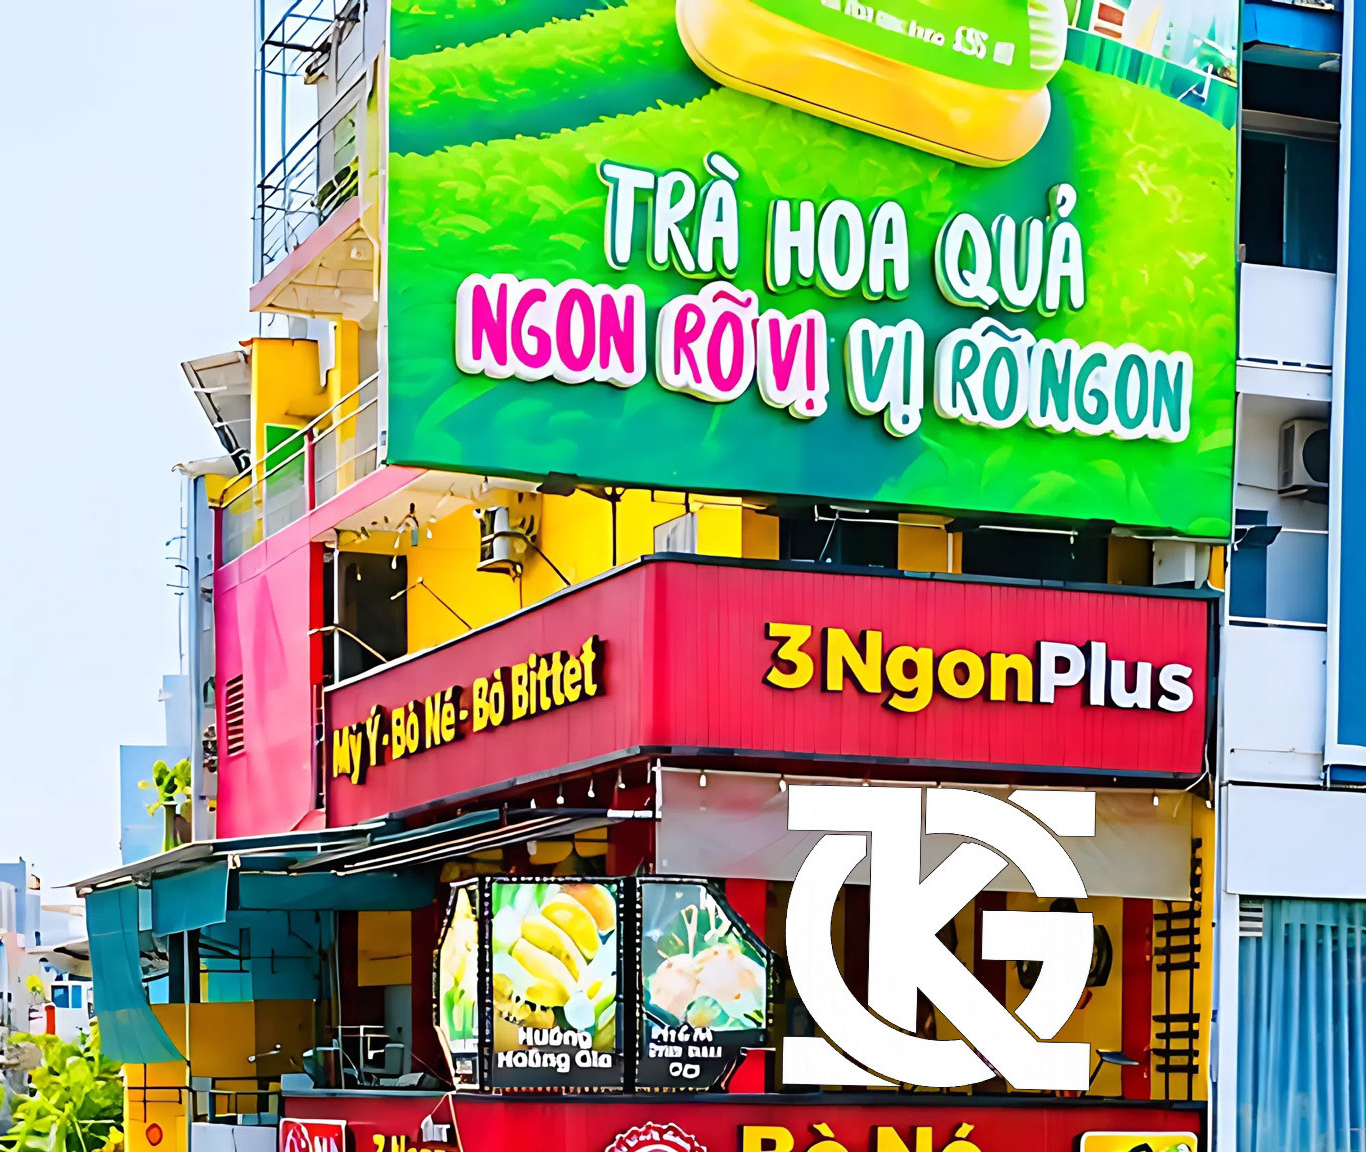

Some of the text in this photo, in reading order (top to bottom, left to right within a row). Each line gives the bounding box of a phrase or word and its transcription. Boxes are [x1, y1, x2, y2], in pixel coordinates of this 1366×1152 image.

[601, 153, 1084, 315] TRÀ HOA QUẢ
[471, 285, 1184, 433] NGON RÕ VỊ VỊ RÕ NGON
[425, 686, 455, 749] Né
[512, 635, 598, 721] Bittet
